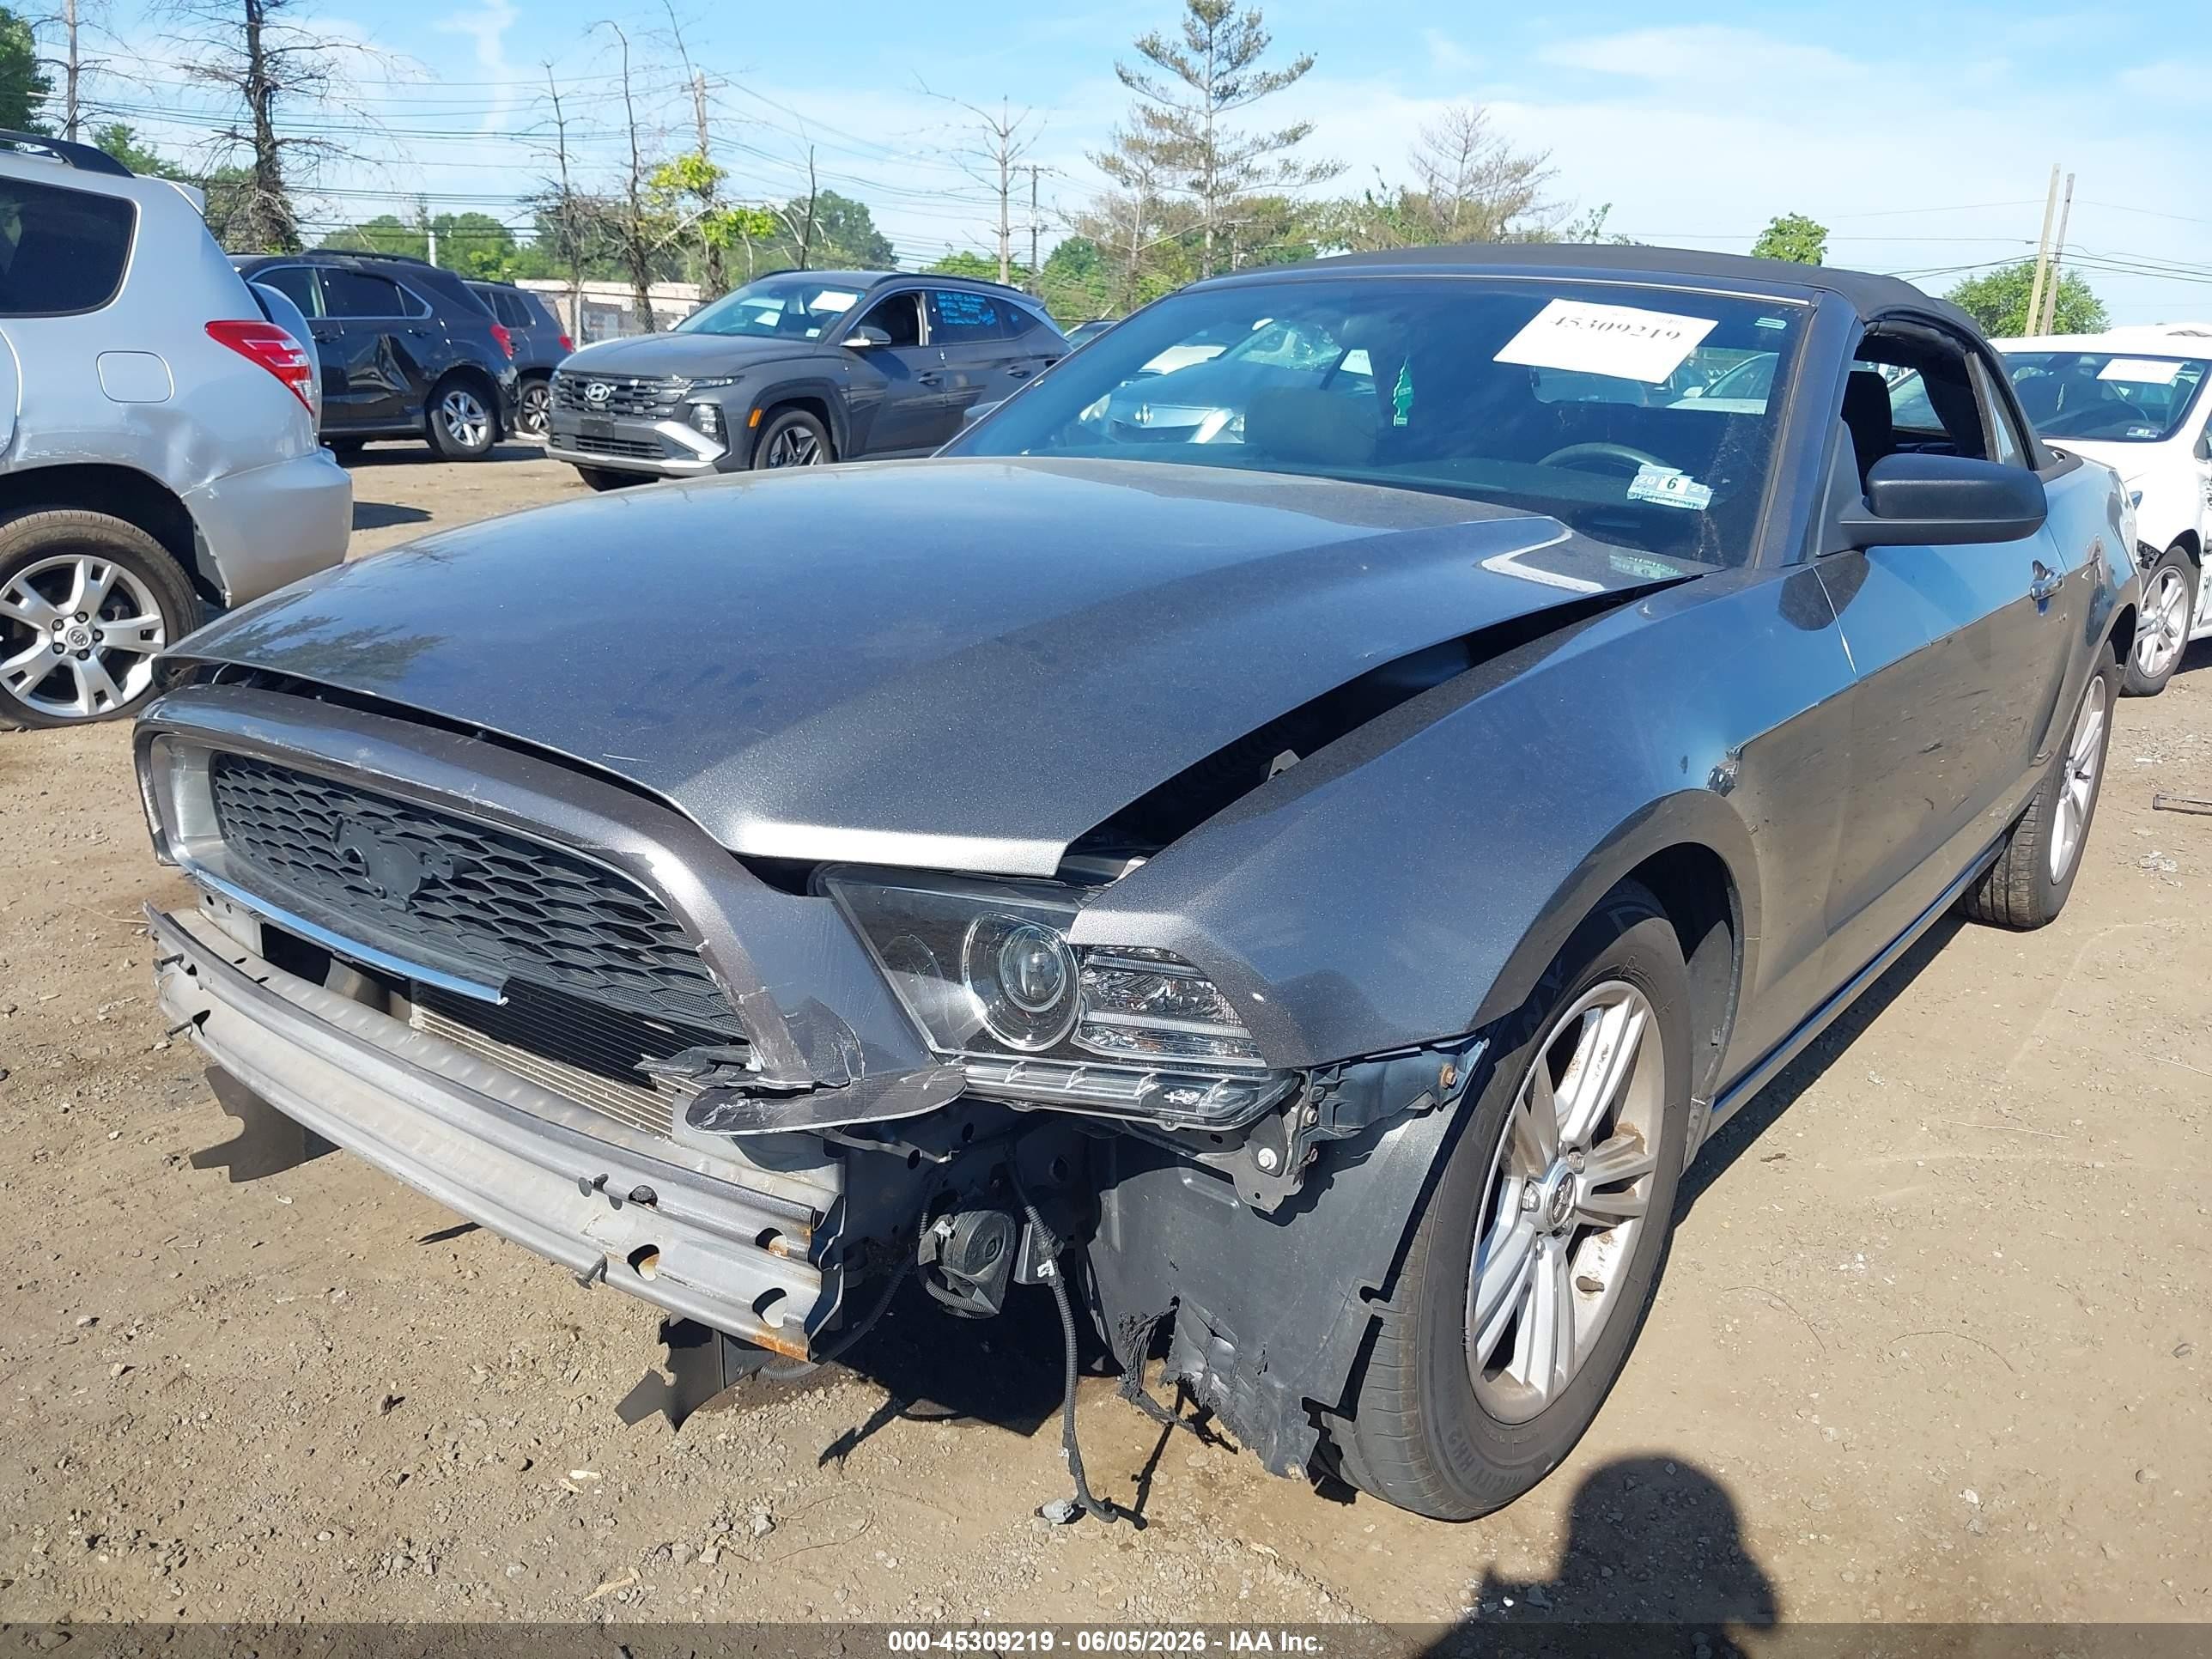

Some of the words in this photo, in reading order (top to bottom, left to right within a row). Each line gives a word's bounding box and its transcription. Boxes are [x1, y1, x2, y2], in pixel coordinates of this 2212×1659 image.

[1550, 316, 1681, 340] 45309219
[1637, 474, 1657, 485] 20
[1667, 477, 1679, 490] 6
